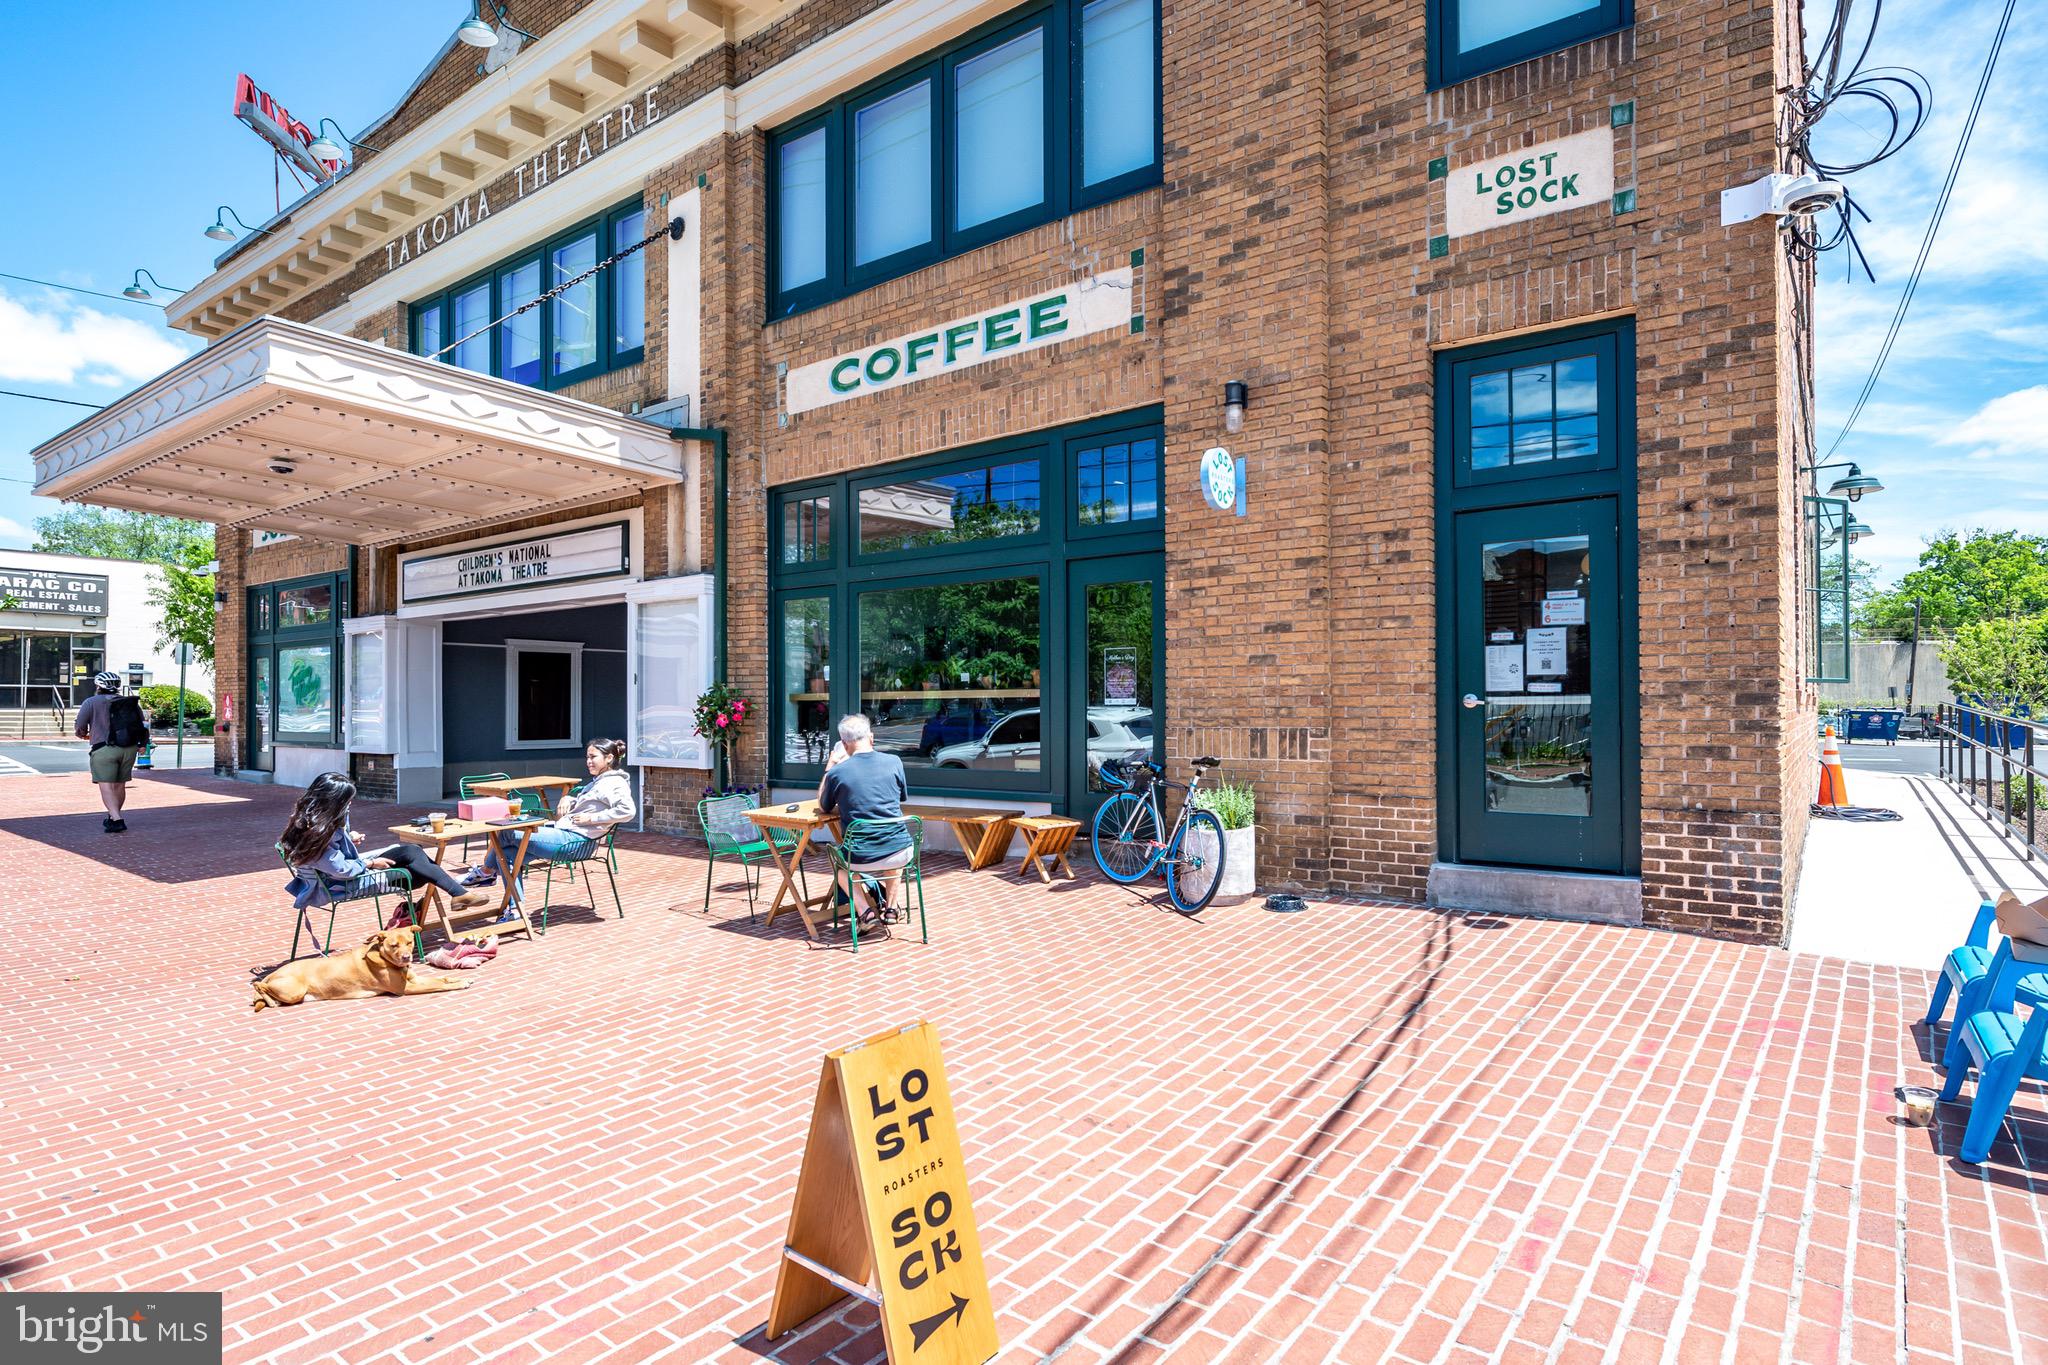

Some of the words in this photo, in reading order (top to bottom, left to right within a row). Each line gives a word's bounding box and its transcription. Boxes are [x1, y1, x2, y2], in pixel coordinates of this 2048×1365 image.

[385, 188, 491, 271] TAKOMA
[514, 85, 660, 199] THEATRE
[1476, 152, 1558, 195] LOST
[1496, 173, 1580, 215] SOCK
[828, 294, 1069, 396] COFFEE
[1212, 452, 1233, 473] LOST
[1212, 481, 1234, 504] SOCK
[457, 551, 503, 573] CHILDREN'S
[508, 543, 551, 563] NATIONAL
[30, 571, 57, 579] THE
[67, 581, 104, 594] CO.
[457, 574, 468, 588] AT
[470, 568, 503, 587] TAKOMA
[511, 562, 548, 580] THEATRE
[6, 588, 35, 598] REAL
[38, 591, 79, 601] ESTATE
[68, 604, 101, 613] SALES
[884, 1157, 944, 1195] ROASTERS
